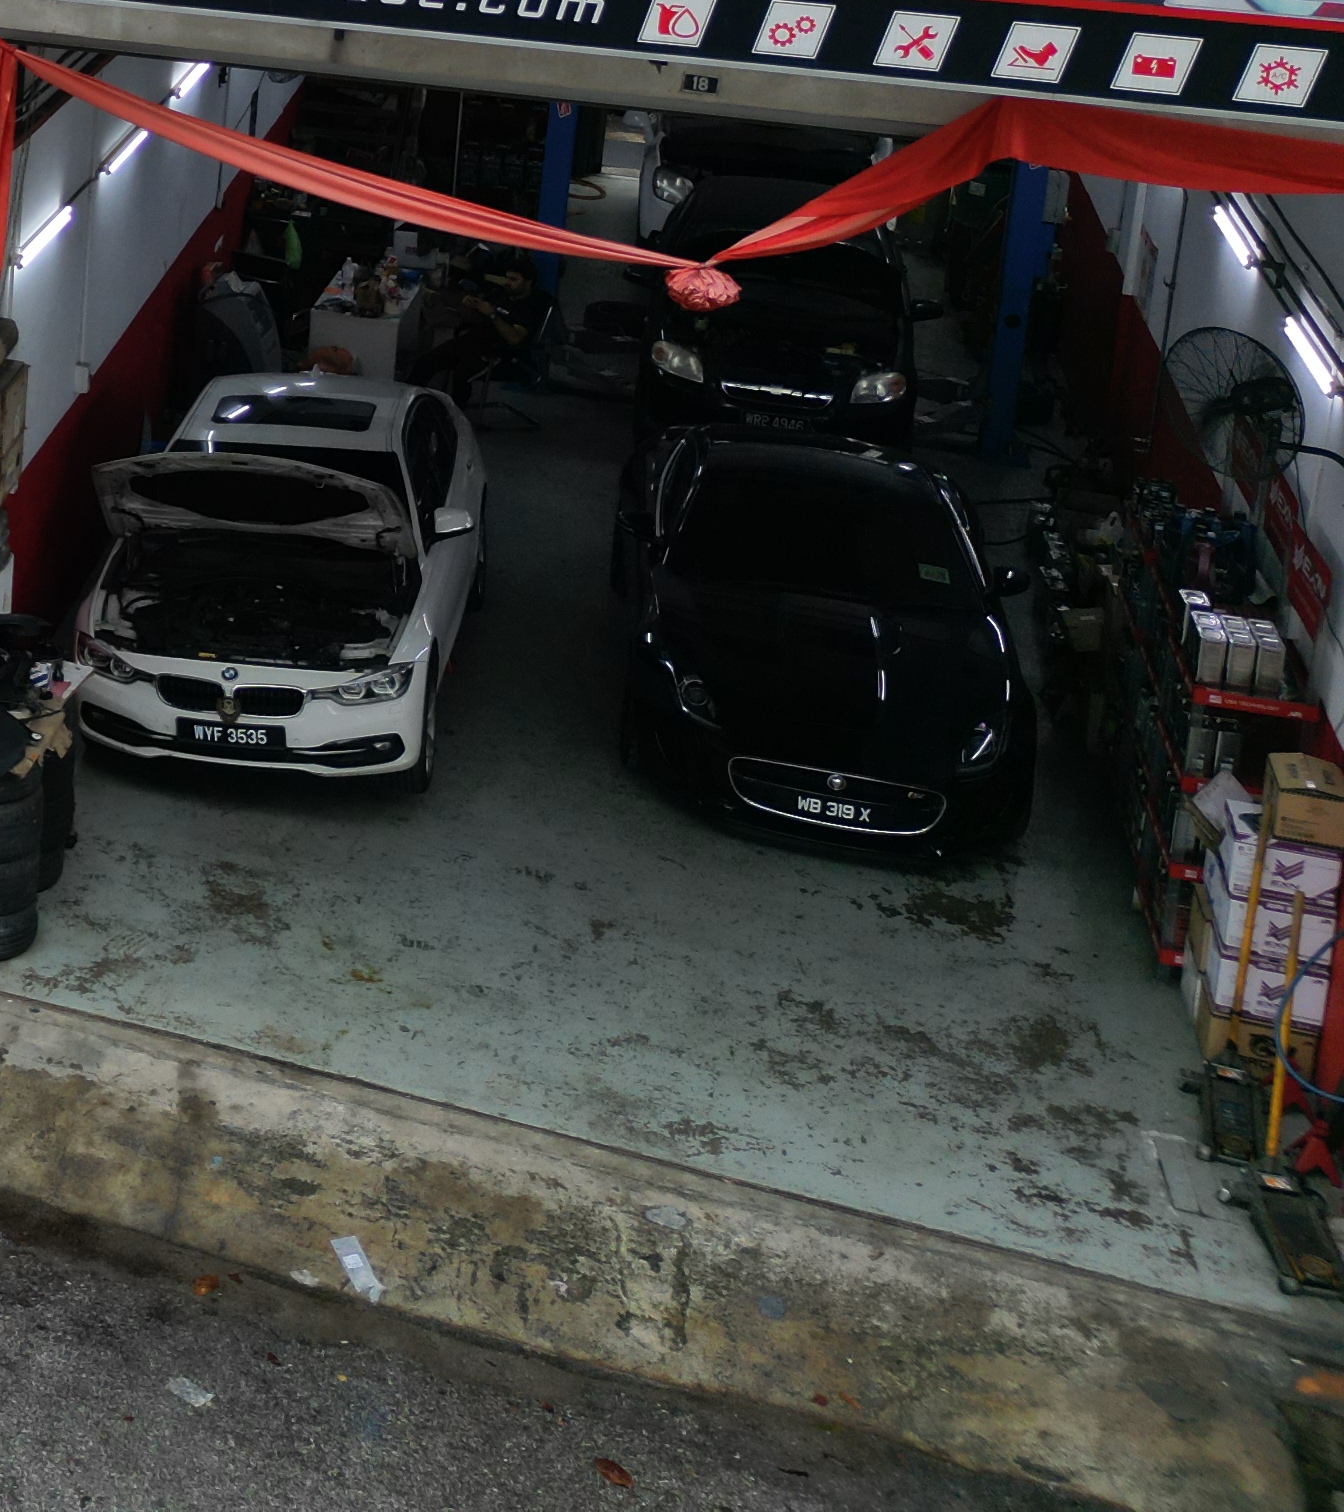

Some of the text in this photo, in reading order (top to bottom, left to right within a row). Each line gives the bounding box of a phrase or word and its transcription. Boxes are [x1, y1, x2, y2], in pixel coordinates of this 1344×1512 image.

[193, 724, 267, 745] WYF 3535
[798, 796, 872, 823] WB 319 X
